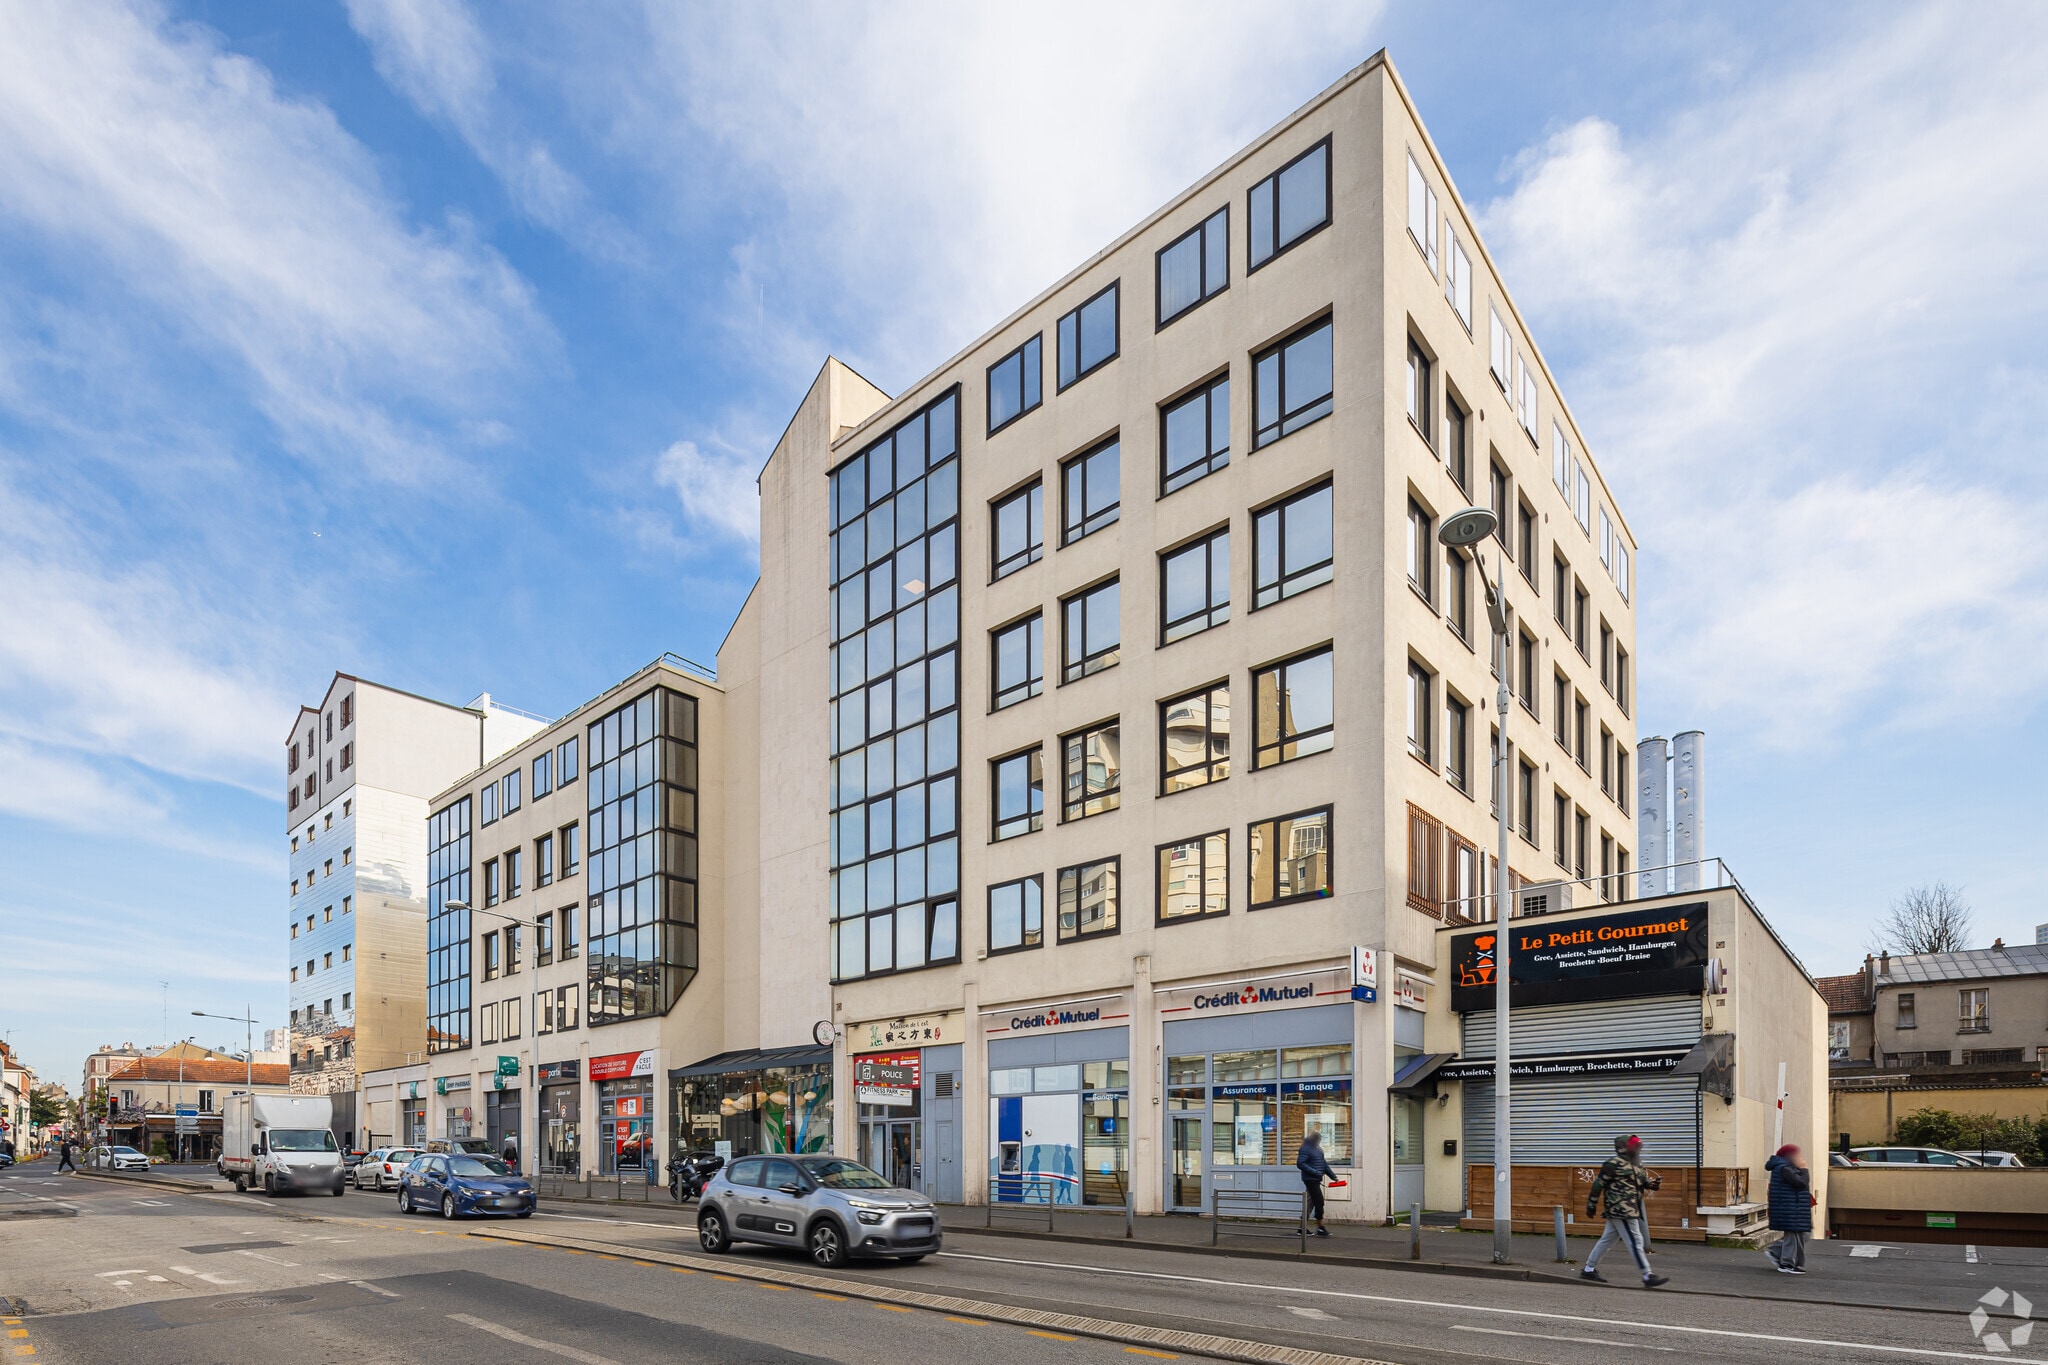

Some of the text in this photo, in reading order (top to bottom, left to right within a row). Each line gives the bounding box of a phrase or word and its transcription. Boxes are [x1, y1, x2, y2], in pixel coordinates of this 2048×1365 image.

[1520, 917, 1689, 950] Le Petit Gourmet
[1554, 950, 1586, 960] Assiette,
[1587, 944, 1626, 956] Sandwich,
[1628, 939, 1677, 951] Hamburger,
[1559, 958, 1596, 968] Brochette
[1625, 952, 1651, 961] Braise
[1193, 982, 1313, 1009] Crédit Mutuel
[1010, 1008, 1100, 1030] Crédit Mutuel
[889, 1022, 909, 1030] Maison
[1459, 1068, 1492, 1077] Assiette,
[1535, 1064, 1585, 1074] Hamburger,
[1587, 1061, 1632, 1070] Brochette,
[1634, 1059, 1662, 1068] Boeuf
[881, 1070, 903, 1079] POLICE
[867, 1086, 886, 1094] FITNESS
[1222, 1086, 1267, 1095] Assurances
[1298, 1082, 1334, 1091] Banque
[1092, 1093, 1119, 1102] Banque
